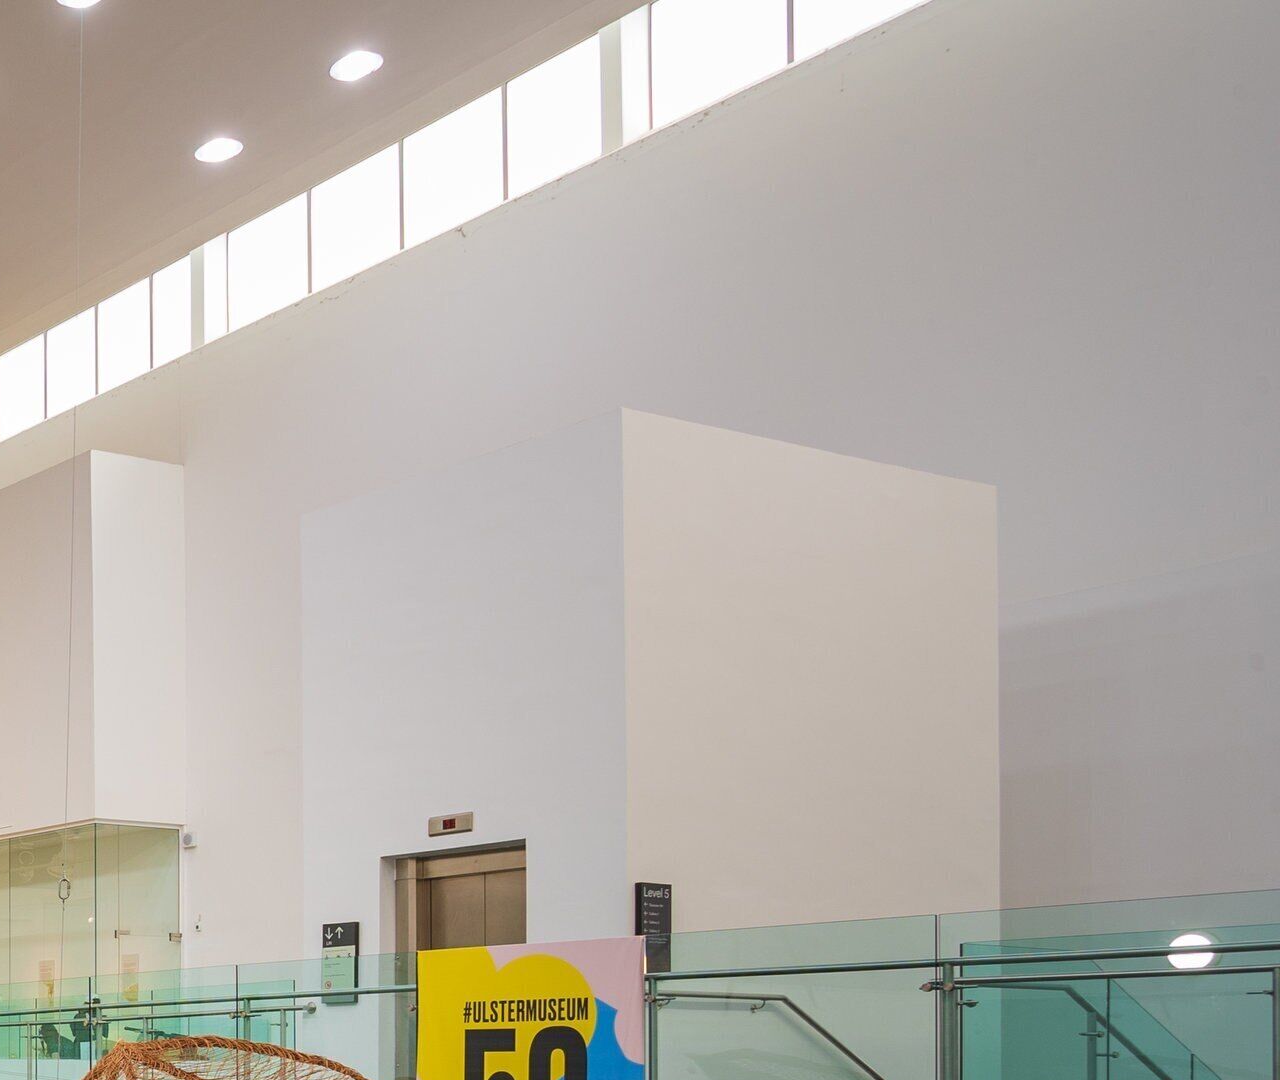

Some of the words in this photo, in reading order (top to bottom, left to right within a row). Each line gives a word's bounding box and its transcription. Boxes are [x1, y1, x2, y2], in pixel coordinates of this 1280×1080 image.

[643, 886, 663, 899] Level
[664, 888, 670, 899] 5
[463, 997, 589, 1023] #ULSTERMUSEUM
